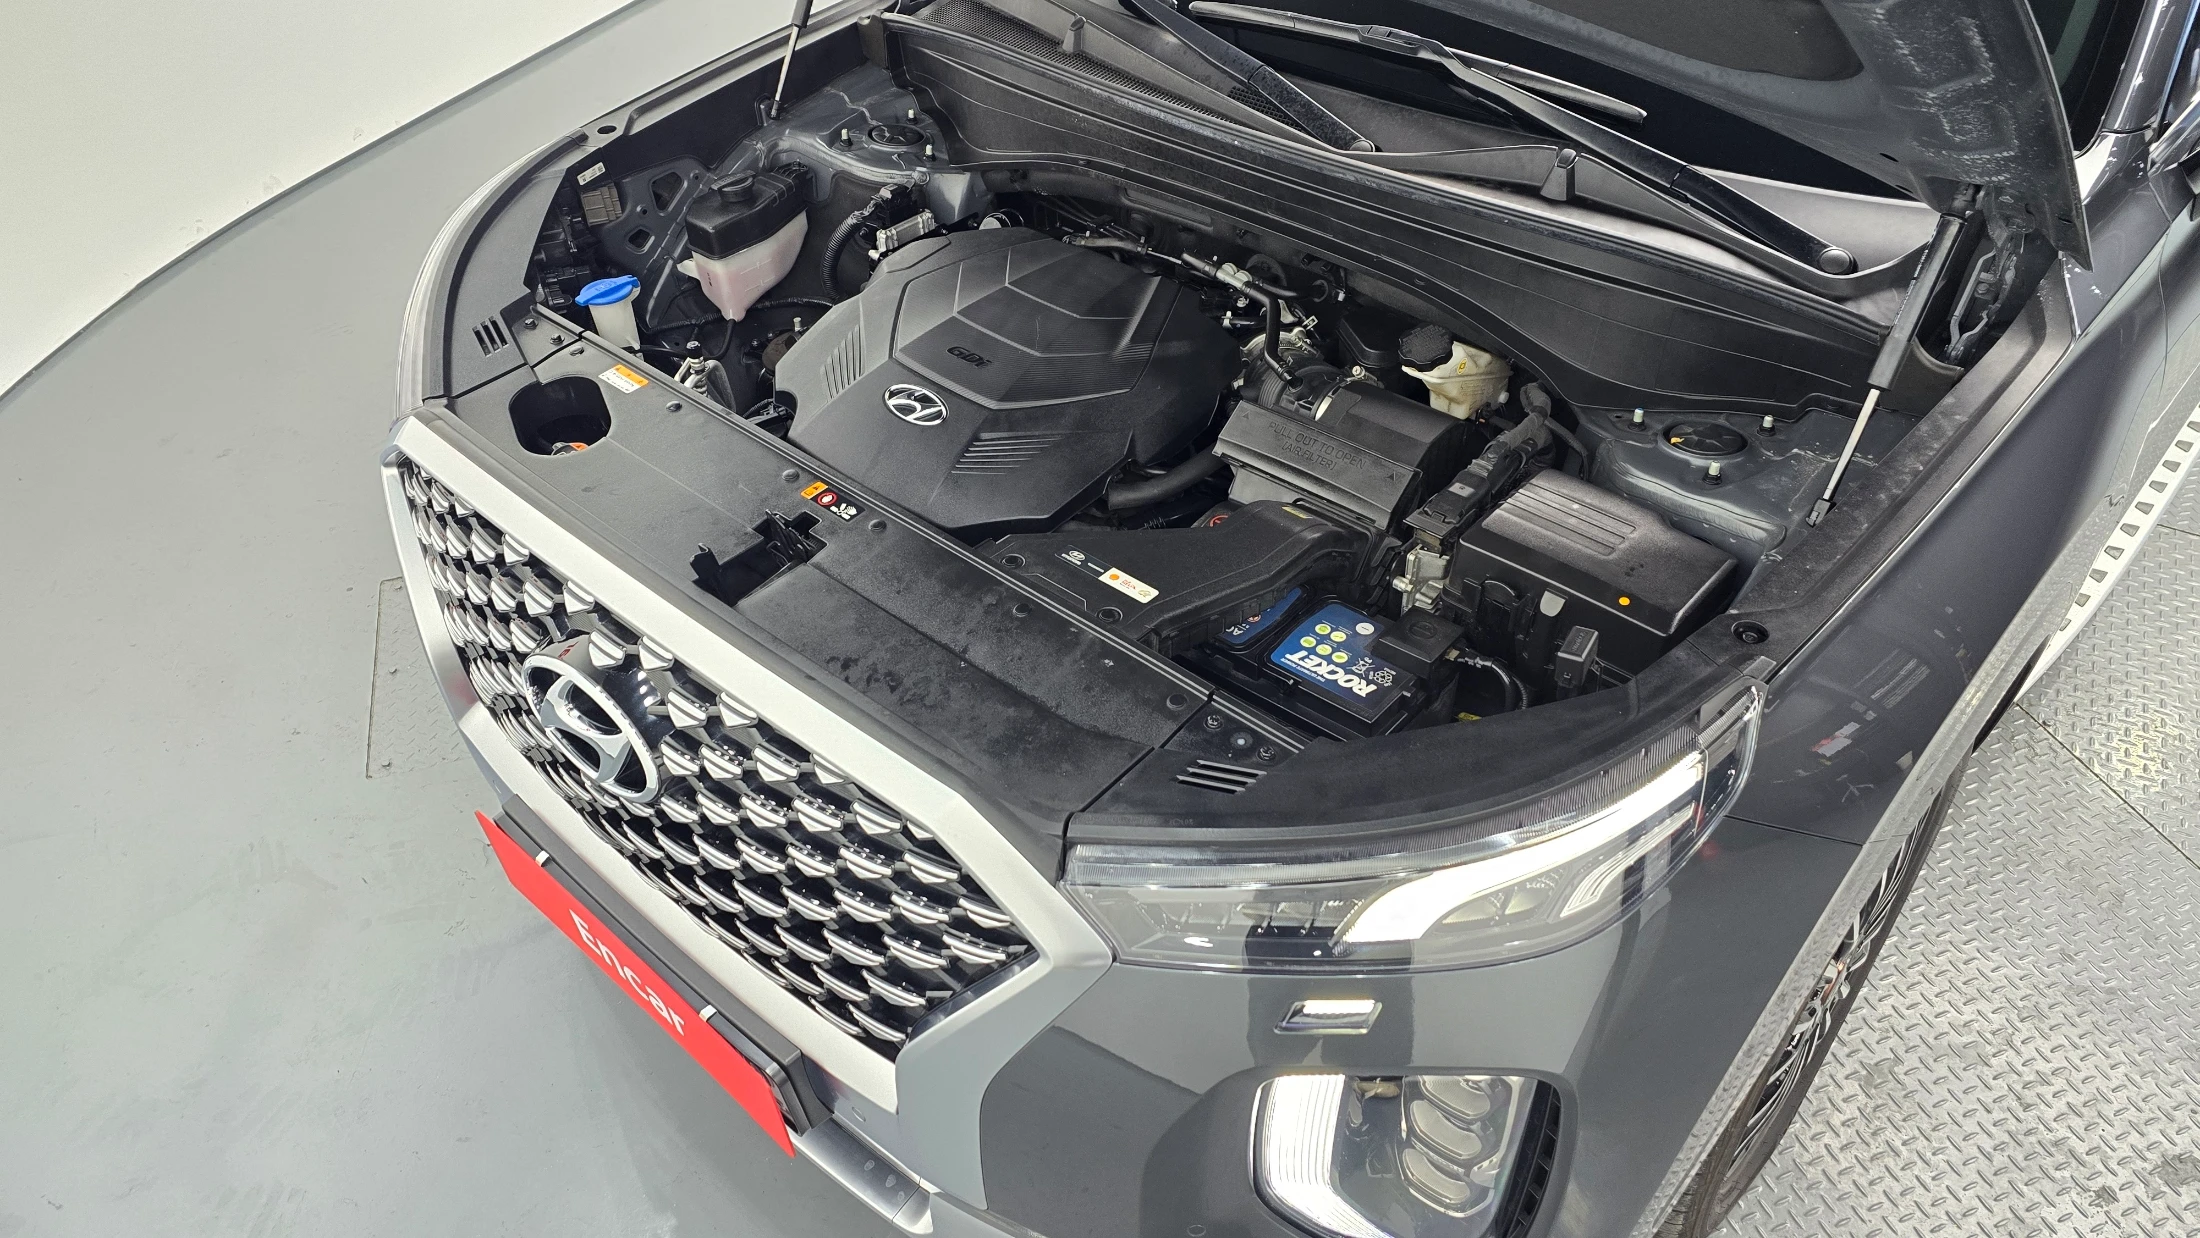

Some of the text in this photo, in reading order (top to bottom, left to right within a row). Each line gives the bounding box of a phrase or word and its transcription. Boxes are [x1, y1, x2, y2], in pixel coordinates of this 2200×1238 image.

[1268, 421, 1367, 469] PULL OUT TO OPEN
[1285, 650, 1377, 698] ROCKET
[569, 908, 685, 1036] Encar
